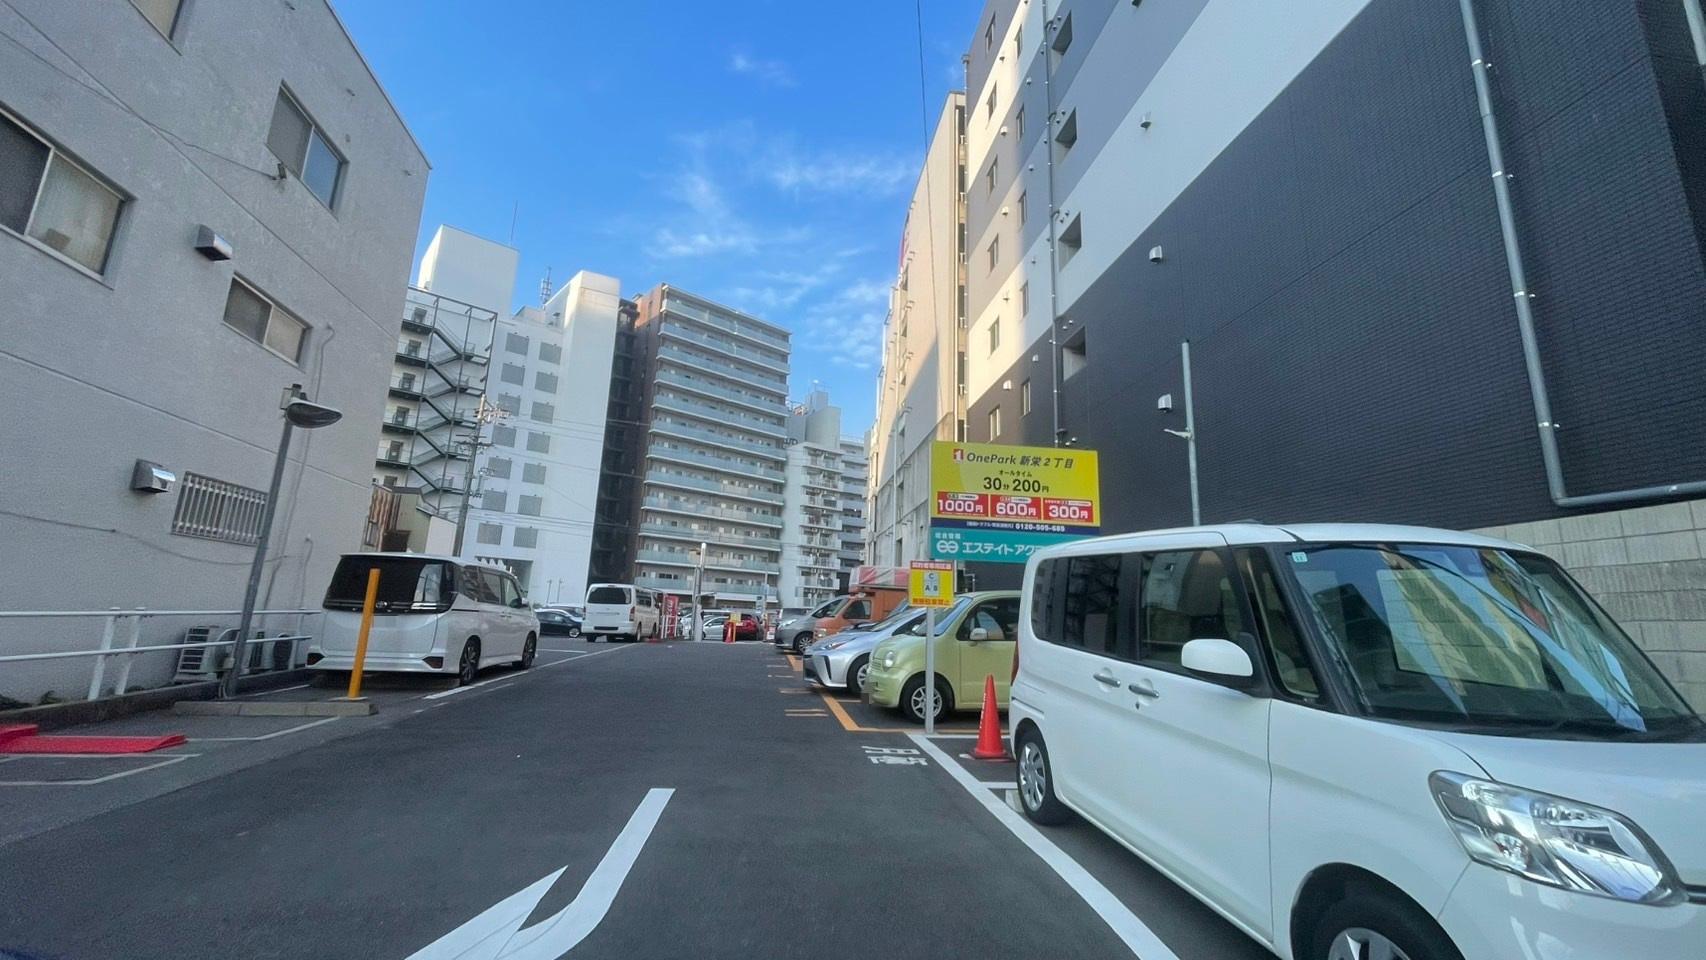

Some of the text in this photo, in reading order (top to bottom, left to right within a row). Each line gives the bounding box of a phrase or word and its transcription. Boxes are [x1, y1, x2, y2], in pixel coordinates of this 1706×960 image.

[966, 452, 1016, 465] OnePark
[999, 469, 1032, 477] オールタイム
[983, 477, 1049, 493] 30分 200円
[938, 499, 983, 513] 1000円
[996, 503, 1036, 516] 600円
[1048, 505, 1089, 519] 300円
